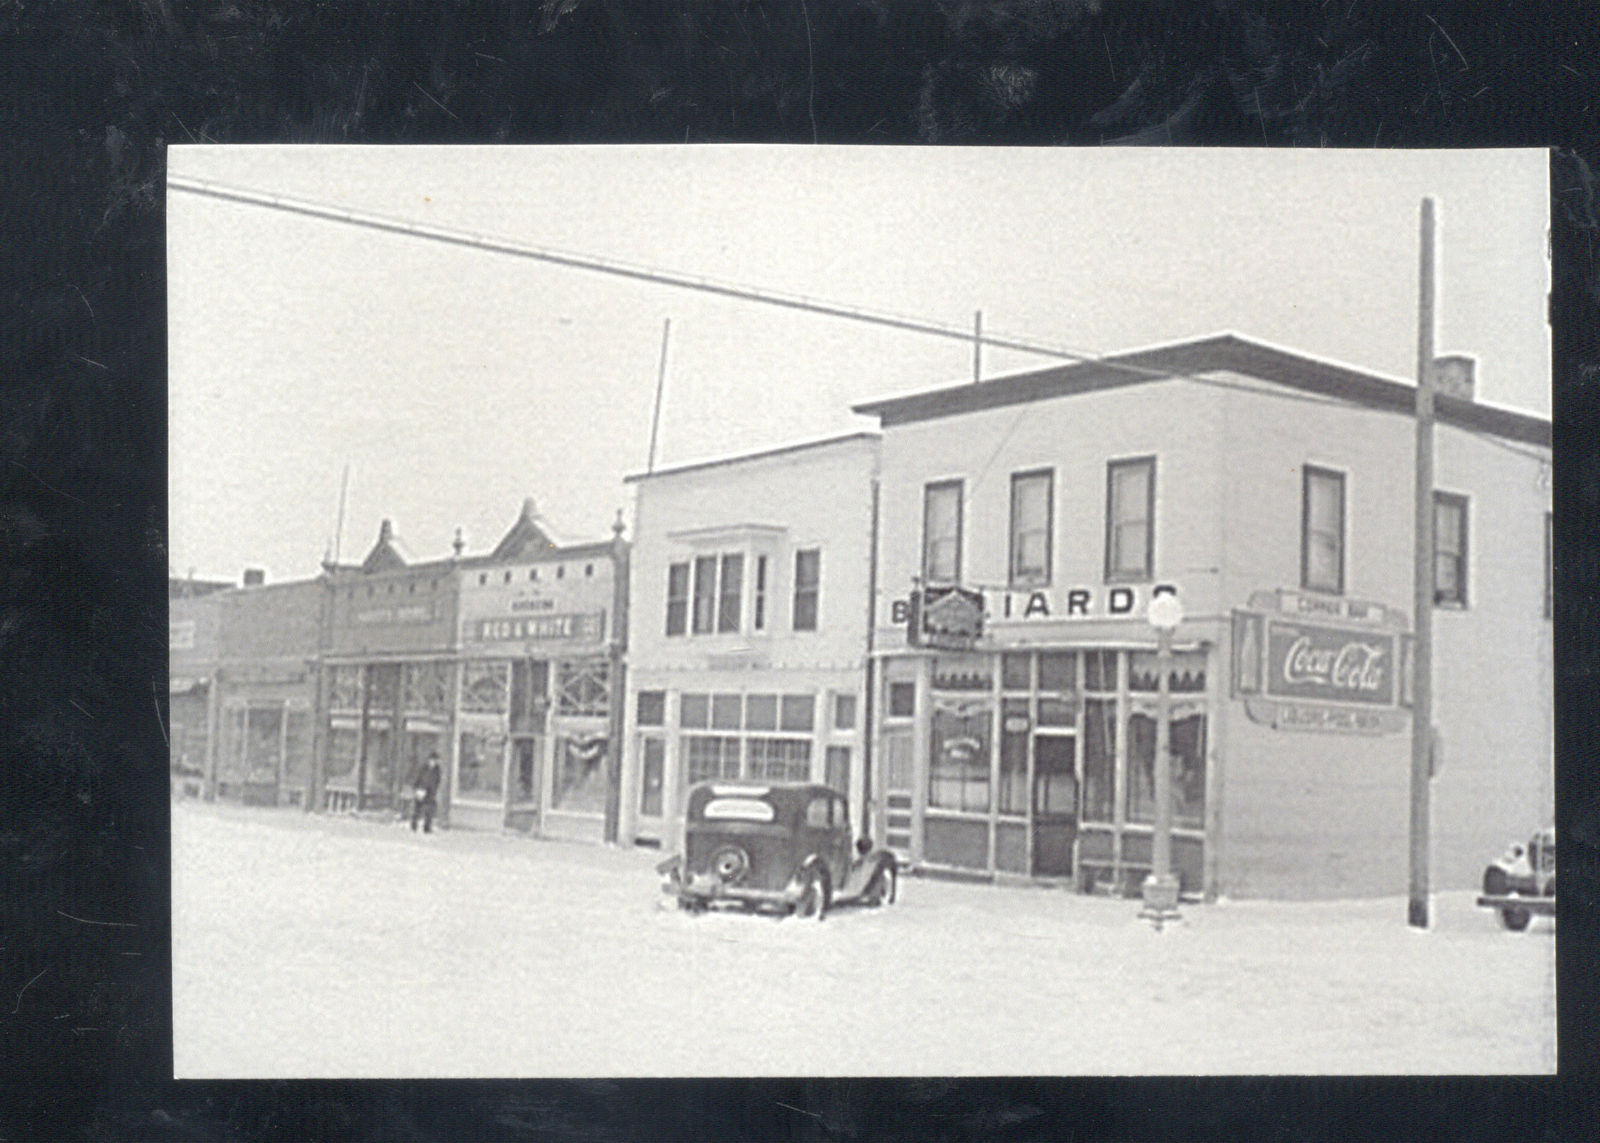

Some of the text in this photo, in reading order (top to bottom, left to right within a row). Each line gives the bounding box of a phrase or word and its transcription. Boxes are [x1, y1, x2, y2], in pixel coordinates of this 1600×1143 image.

[483, 621, 511, 639] RED
[527, 617, 572, 637] WHITE
[1284, 636, 1384, 690] Coca Cola
